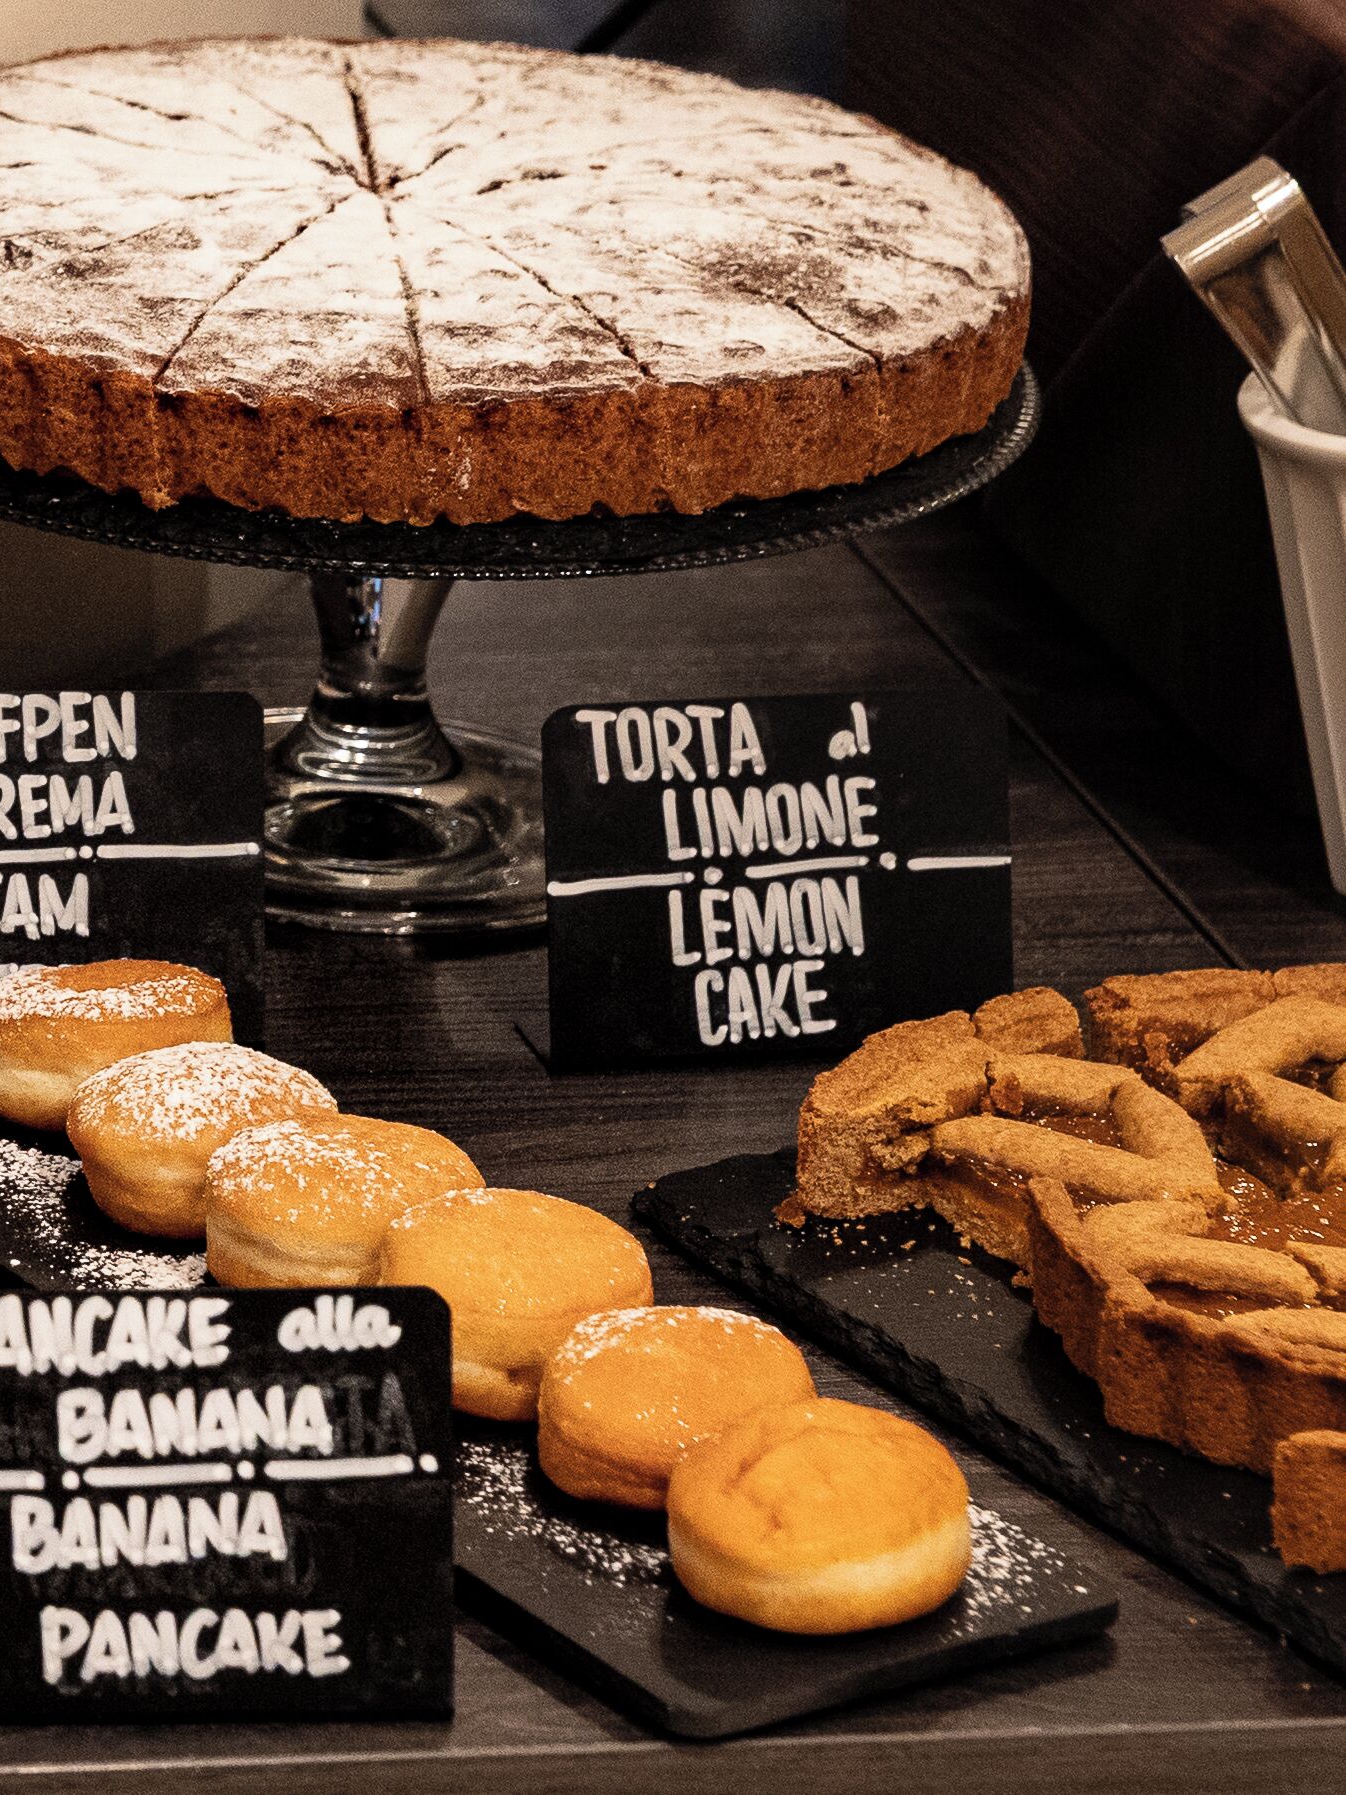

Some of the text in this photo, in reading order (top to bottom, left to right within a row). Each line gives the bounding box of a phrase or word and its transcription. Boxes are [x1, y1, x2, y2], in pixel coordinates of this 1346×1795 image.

[575, 702, 767, 784] TORTA
[662, 774, 880, 861] LIMONE
[668, 876, 864, 967] LEMON
[693, 960, 837, 1046] CAKE
[277, 1294, 402, 1353] alla
[56, 1385, 334, 1464] BANANA
[10, 1491, 288, 1575] BANANA
[39, 1605, 351, 1685] PANCAKE
